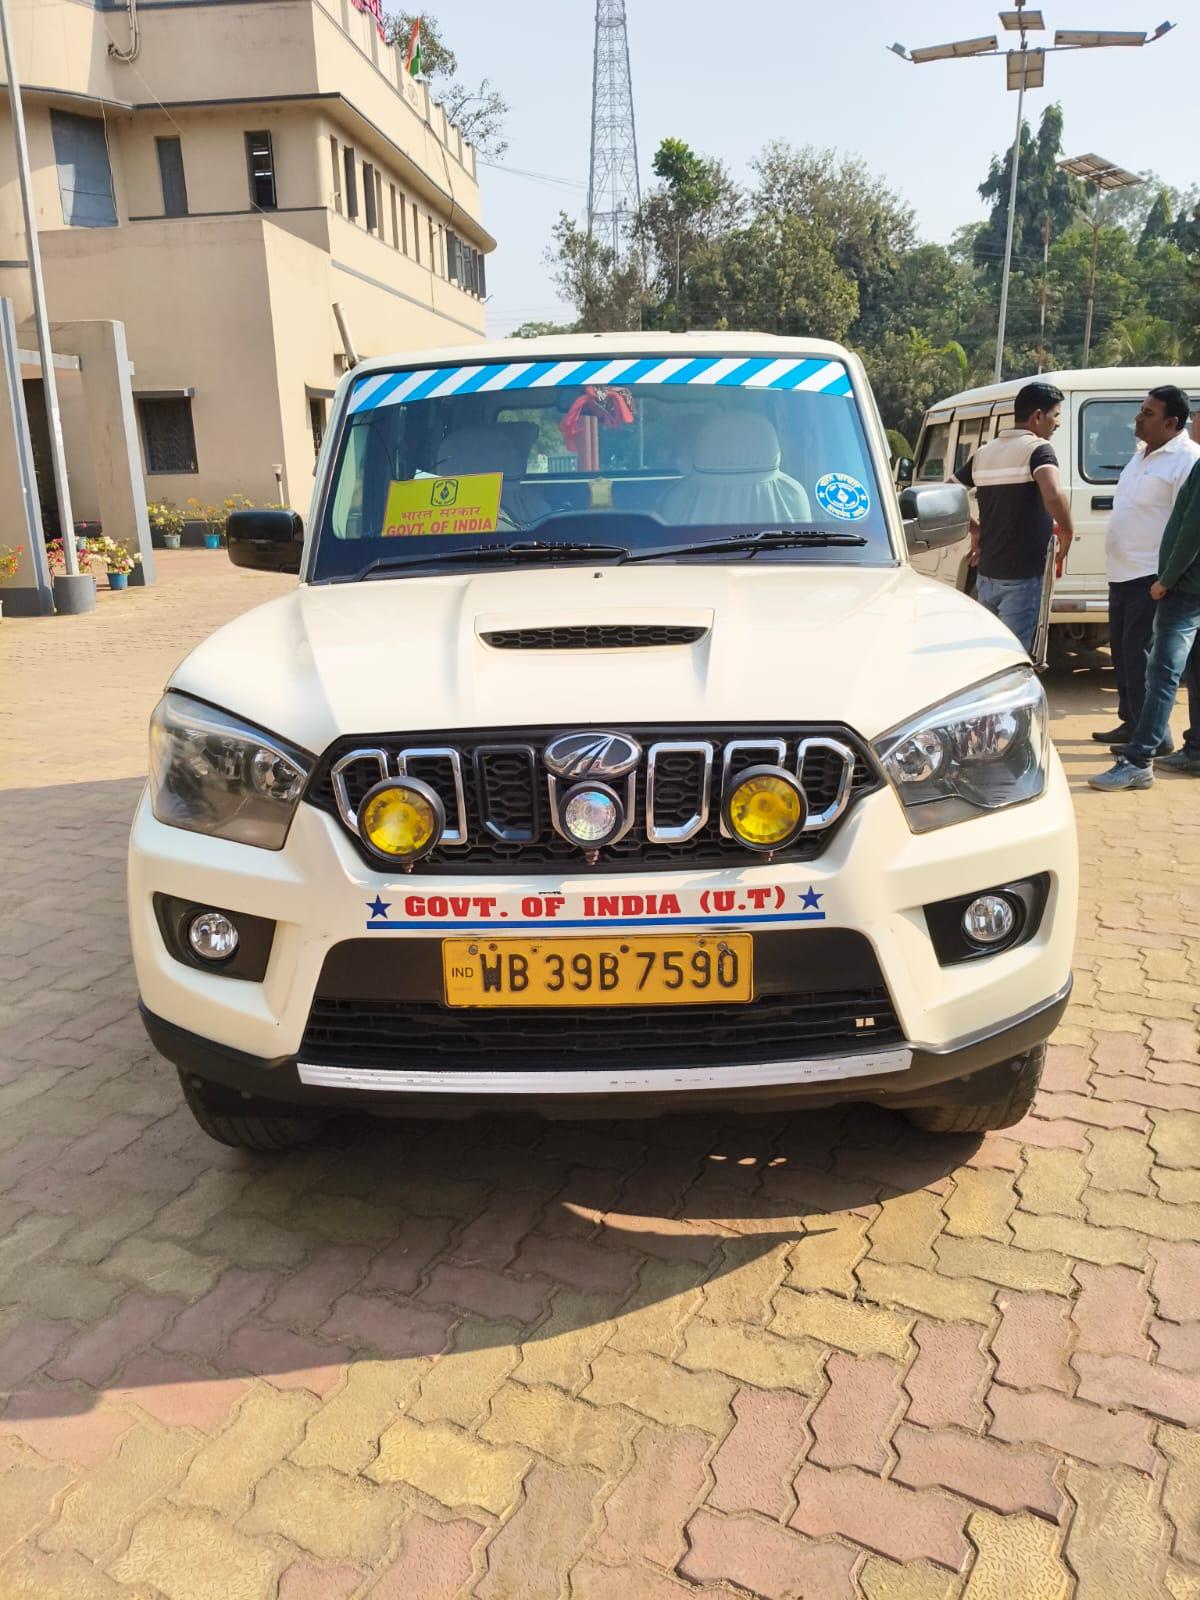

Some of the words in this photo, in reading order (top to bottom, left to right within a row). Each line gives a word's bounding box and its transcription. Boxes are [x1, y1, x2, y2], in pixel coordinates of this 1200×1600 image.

[430, 520, 449, 533] OF
[453, 517, 491, 532] INDIA
[405, 896, 508, 917] GOVT.
[522, 896, 565, 917] OF
[583, 894, 681, 917] INDIA
[700, 886, 785, 913] (U.T)
[451, 967, 474, 978] IND
[480, 953, 529, 992] WB
[545, 953, 619, 991] 39B
[636, 950, 738, 988] 7590
